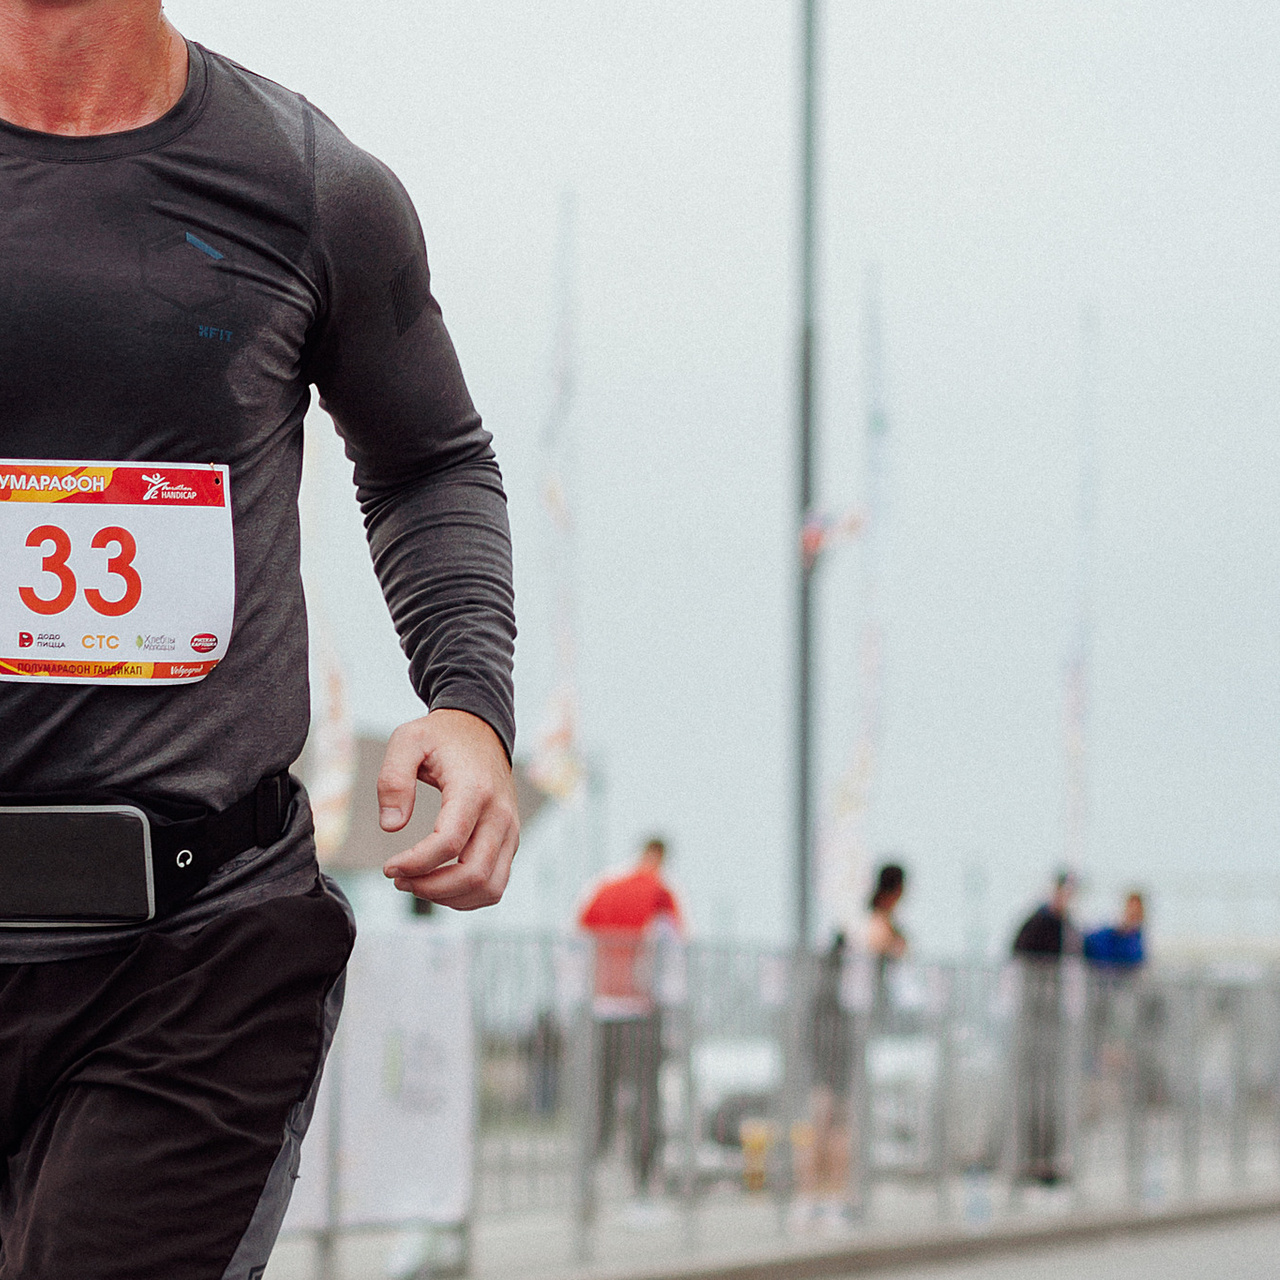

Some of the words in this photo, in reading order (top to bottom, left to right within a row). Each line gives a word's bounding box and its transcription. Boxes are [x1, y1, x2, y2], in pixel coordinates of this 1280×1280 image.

[161, 491, 197, 499] HANDICAP
[18, 524, 142, 617] 33
[36, 633, 61, 641] ДОДО
[81, 634, 120, 649] СТС
[17, 662, 90, 675] ПОЛУМАРАФОН
[93, 664, 142, 676] ГАНДИКАП
